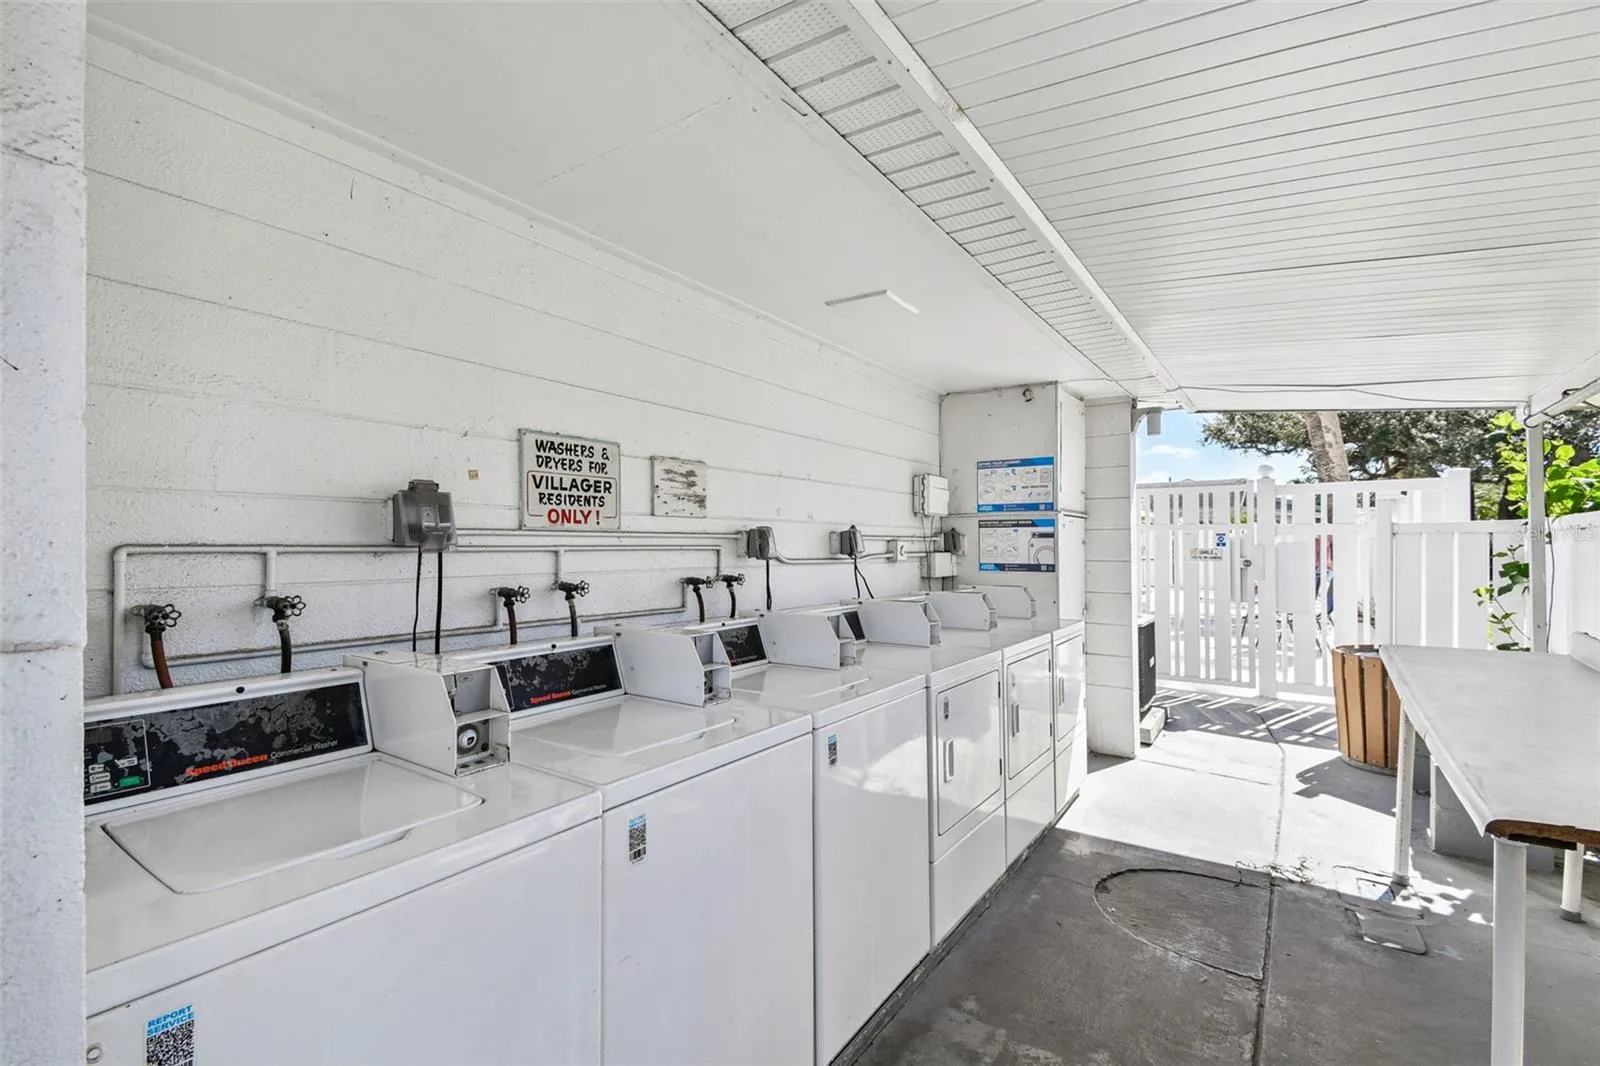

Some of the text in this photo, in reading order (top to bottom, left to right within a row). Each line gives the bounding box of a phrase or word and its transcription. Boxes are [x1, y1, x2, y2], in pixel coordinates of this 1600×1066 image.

[535, 439, 610, 461] WASHERS &
[535, 455, 608, 475] DRYERS FOR
[532, 474, 612, 494] VILLAGER
[538, 492, 605, 508] RESIDENTS
[185, 760, 229, 777] Speed
[270, 745, 312, 760] Commercial
[313, 739, 338, 750] Washer
[146, 1012, 194, 1036] SERVICE
[147, 1004, 193, 1028] REPORT
